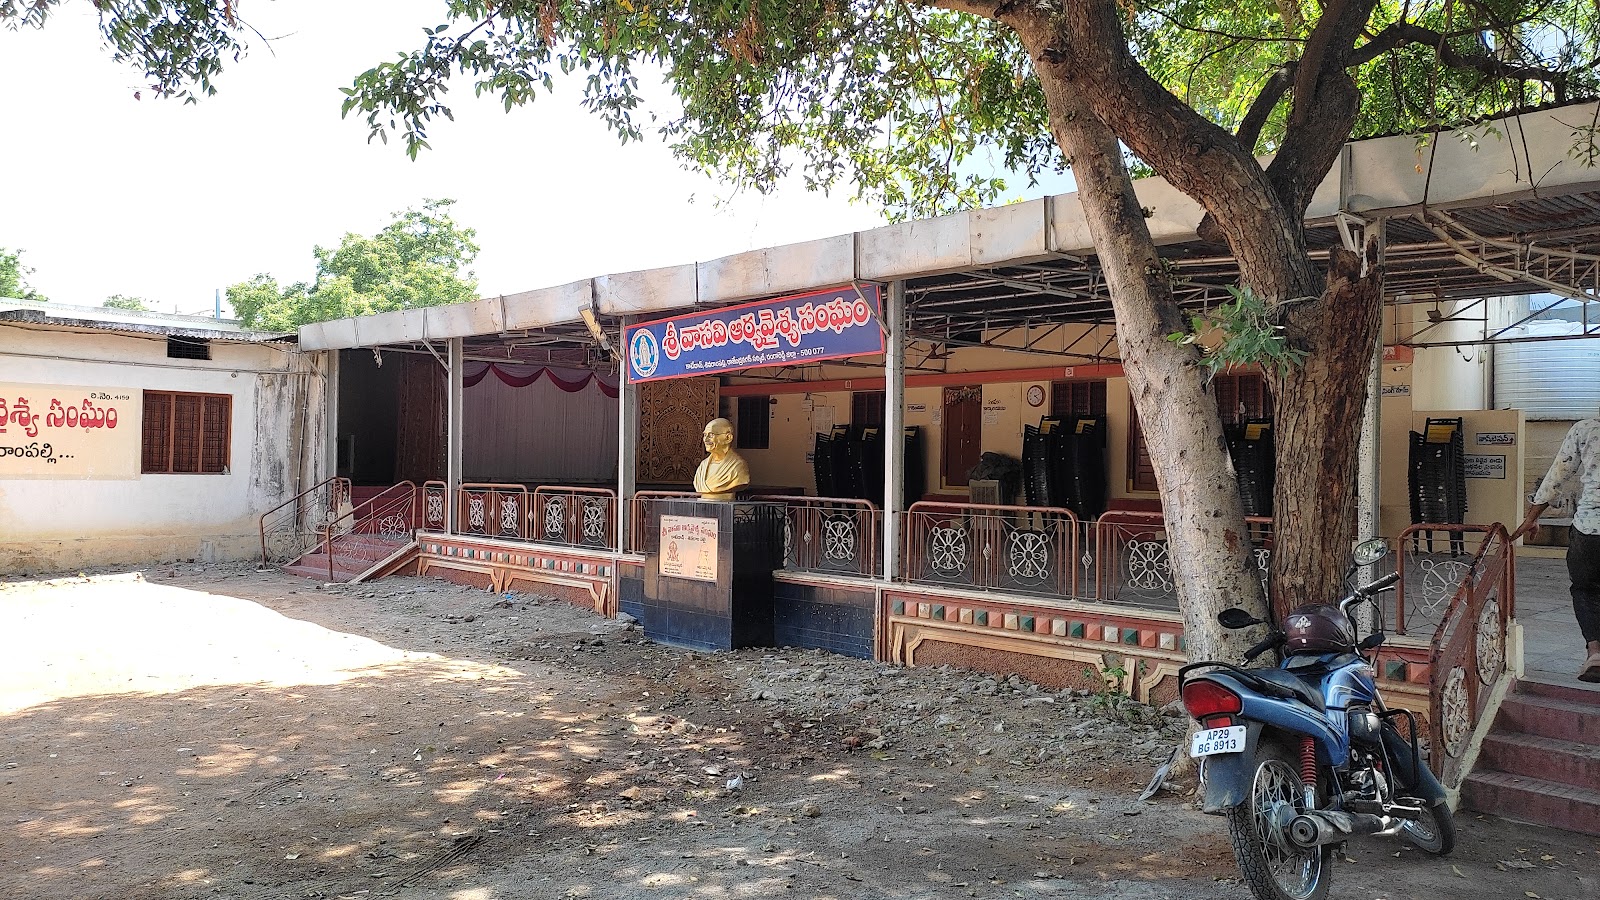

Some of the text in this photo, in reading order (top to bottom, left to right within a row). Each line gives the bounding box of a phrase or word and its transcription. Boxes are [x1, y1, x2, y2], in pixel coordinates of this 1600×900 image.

[662, 321, 680, 360] శ్రీ
[680, 319, 729, 352] వాసవి
[796, 297, 870, 335] సంఘం
[800, 348, 812, 357] 500
[813, 346, 825, 355] 077
[46, 398, 118, 434] సంఘం
[1206, 729, 1230, 742] AP29
[1198, 739, 1237, 754] BG 8913
